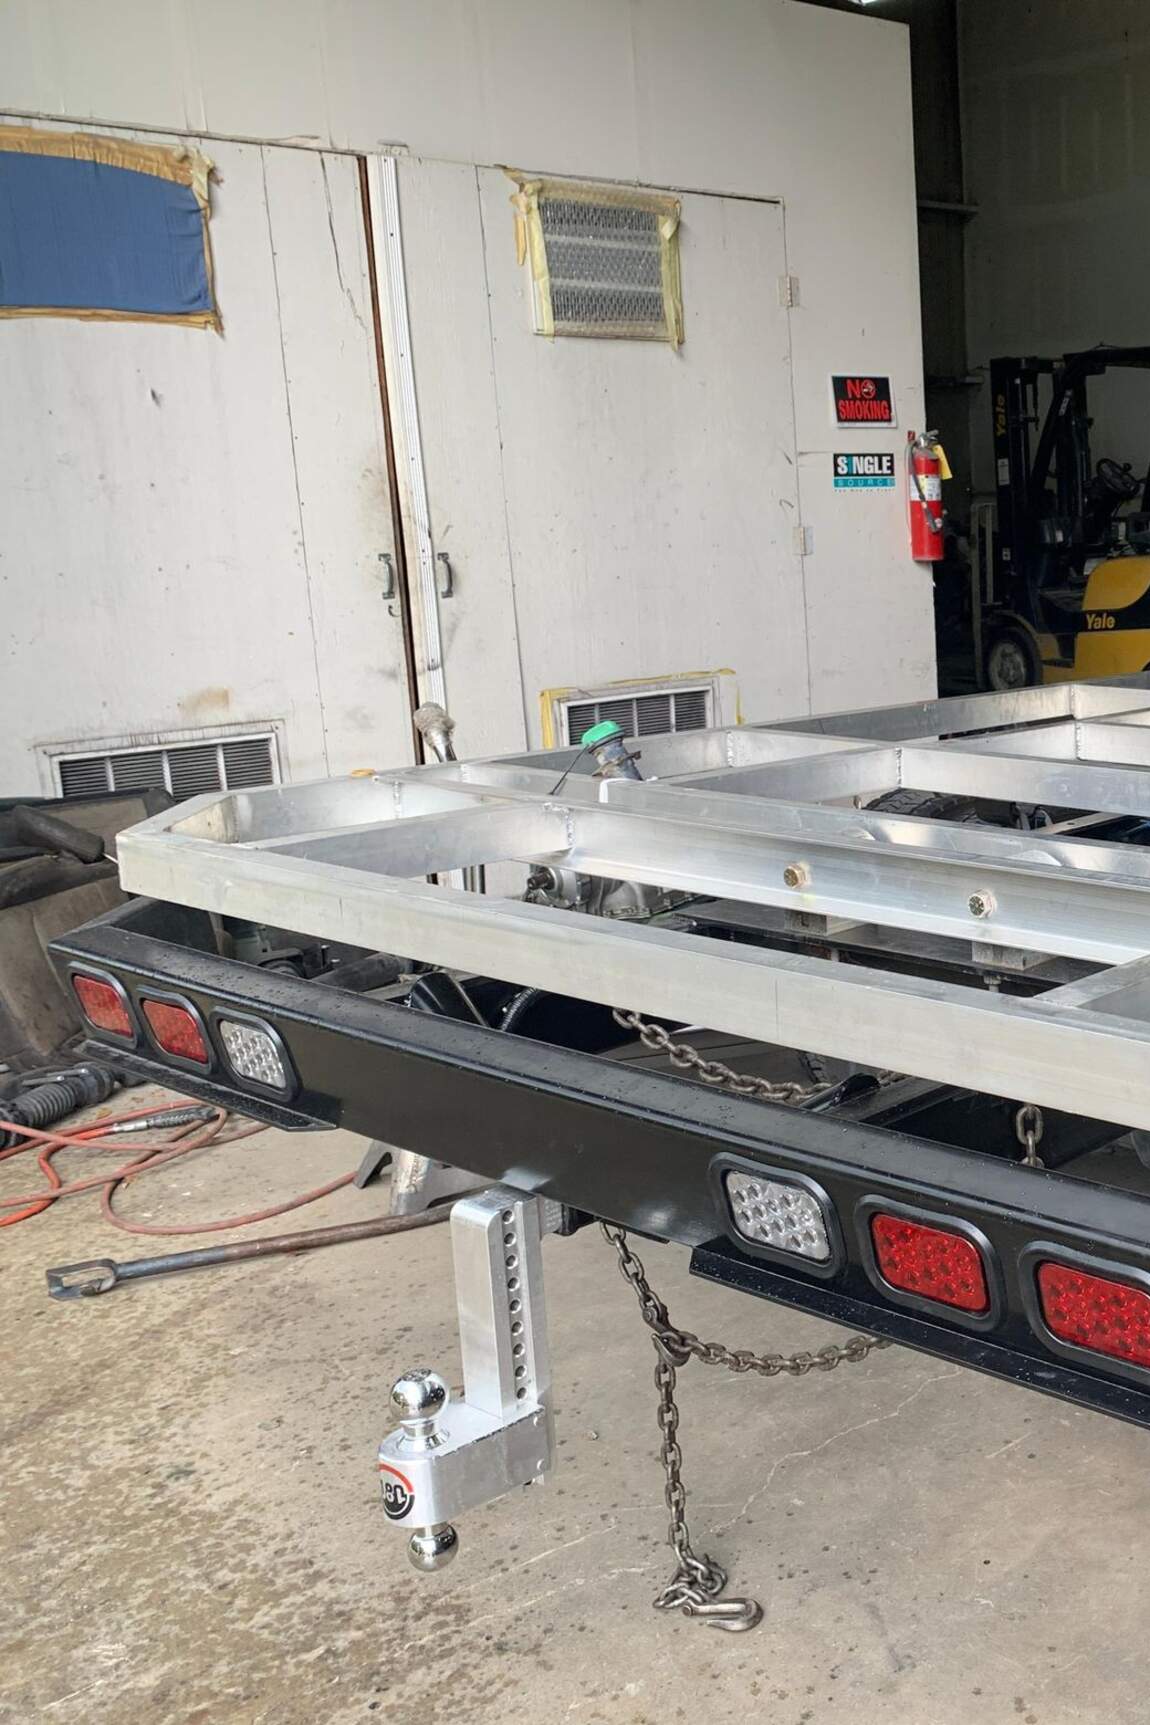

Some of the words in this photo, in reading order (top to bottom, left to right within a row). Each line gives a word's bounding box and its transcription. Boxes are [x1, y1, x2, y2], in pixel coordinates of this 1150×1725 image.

[846, 378, 876, 399] NO
[838, 399, 890, 420] SMOKING
[995, 393, 1007, 437] Yale
[836, 455, 892, 475] SINGLE
[1085, 613, 1116, 630] Yale
